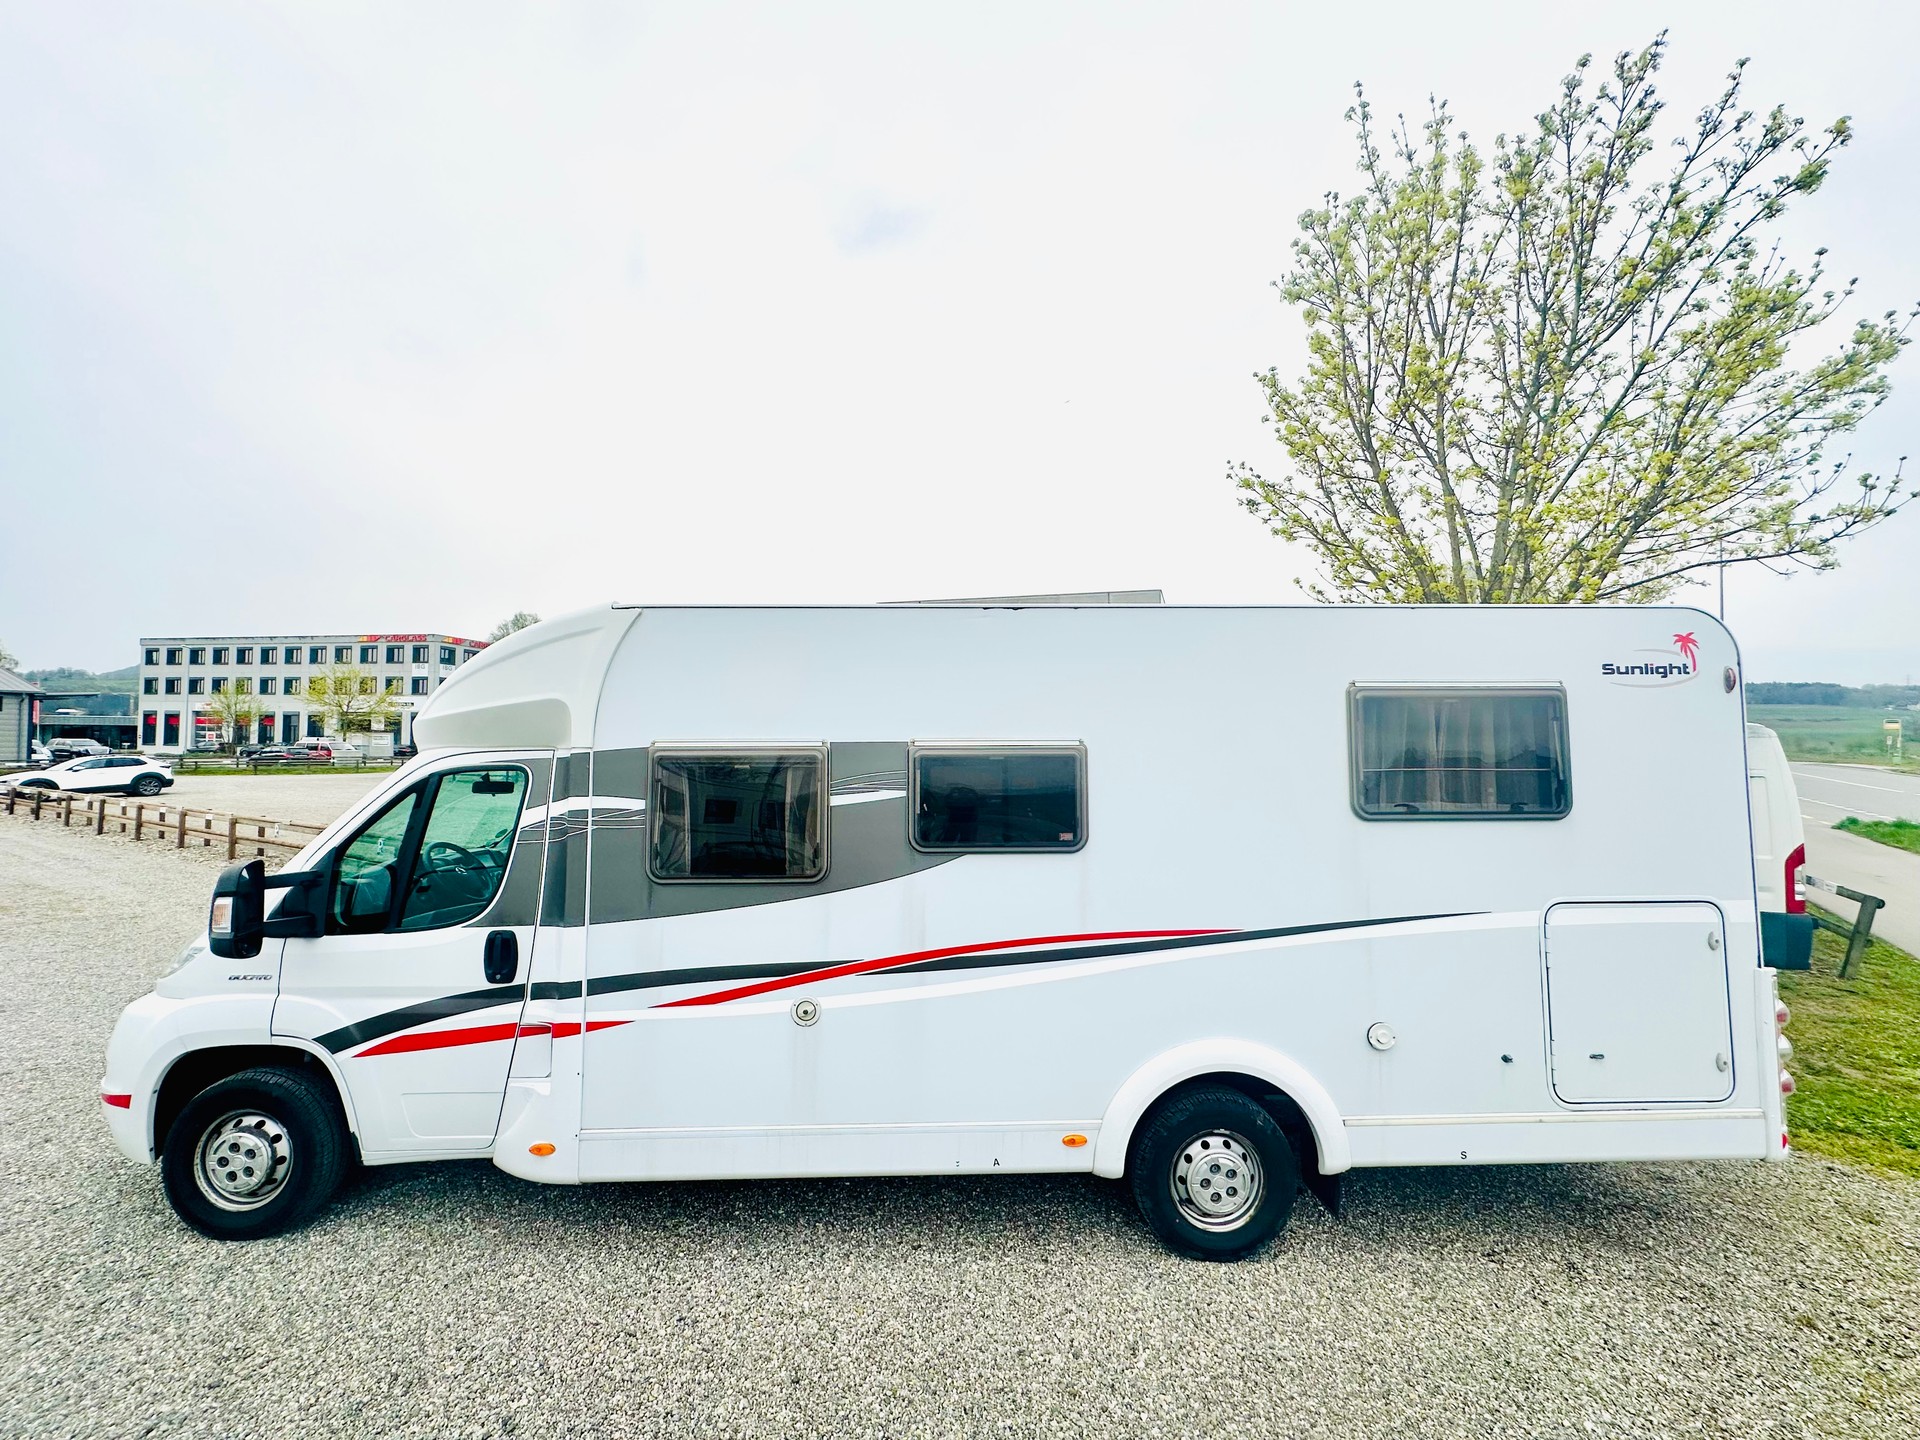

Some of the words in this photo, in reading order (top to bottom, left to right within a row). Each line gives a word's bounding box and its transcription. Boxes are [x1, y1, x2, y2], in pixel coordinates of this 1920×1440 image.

[1602, 663, 1690, 678] Sunlight
[1460, 1151, 1467, 1160] S
[993, 1158, 1000, 1167] A
